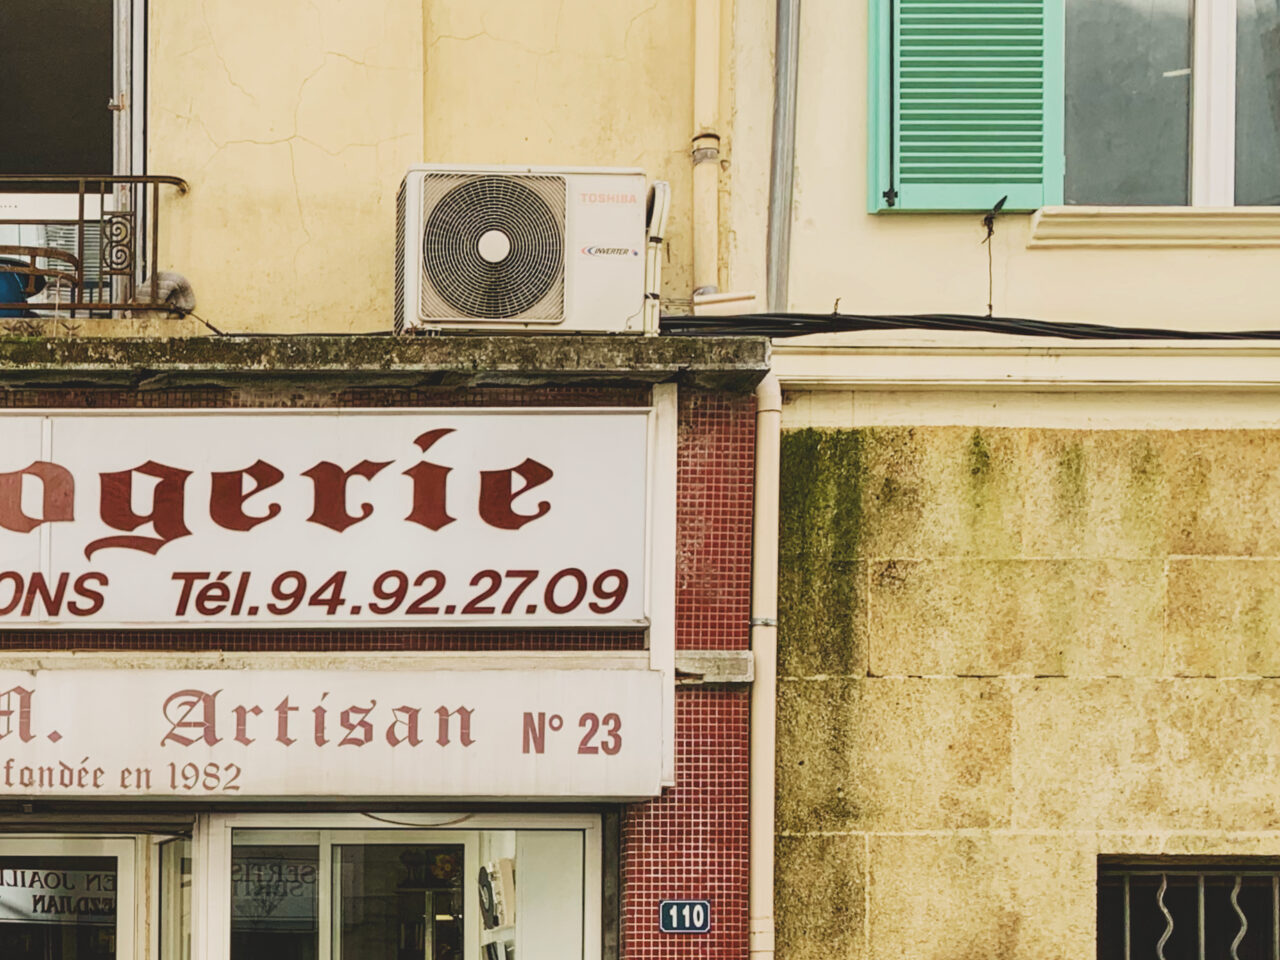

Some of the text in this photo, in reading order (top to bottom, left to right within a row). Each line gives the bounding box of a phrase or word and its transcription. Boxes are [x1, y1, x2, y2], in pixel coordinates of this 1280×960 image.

[580, 192, 638, 205] TOSHIBA
[594, 247, 630, 256] INVERTER
[171, 568, 629, 617] Tél.94.92.27.09
[160, 689, 476, 748] Artisan
[577, 712, 622, 755] 23
[4, 757, 104, 789] fondée
[120, 768, 151, 790] en
[169, 762, 241, 791] 1982
[669, 904, 704, 928] 110
